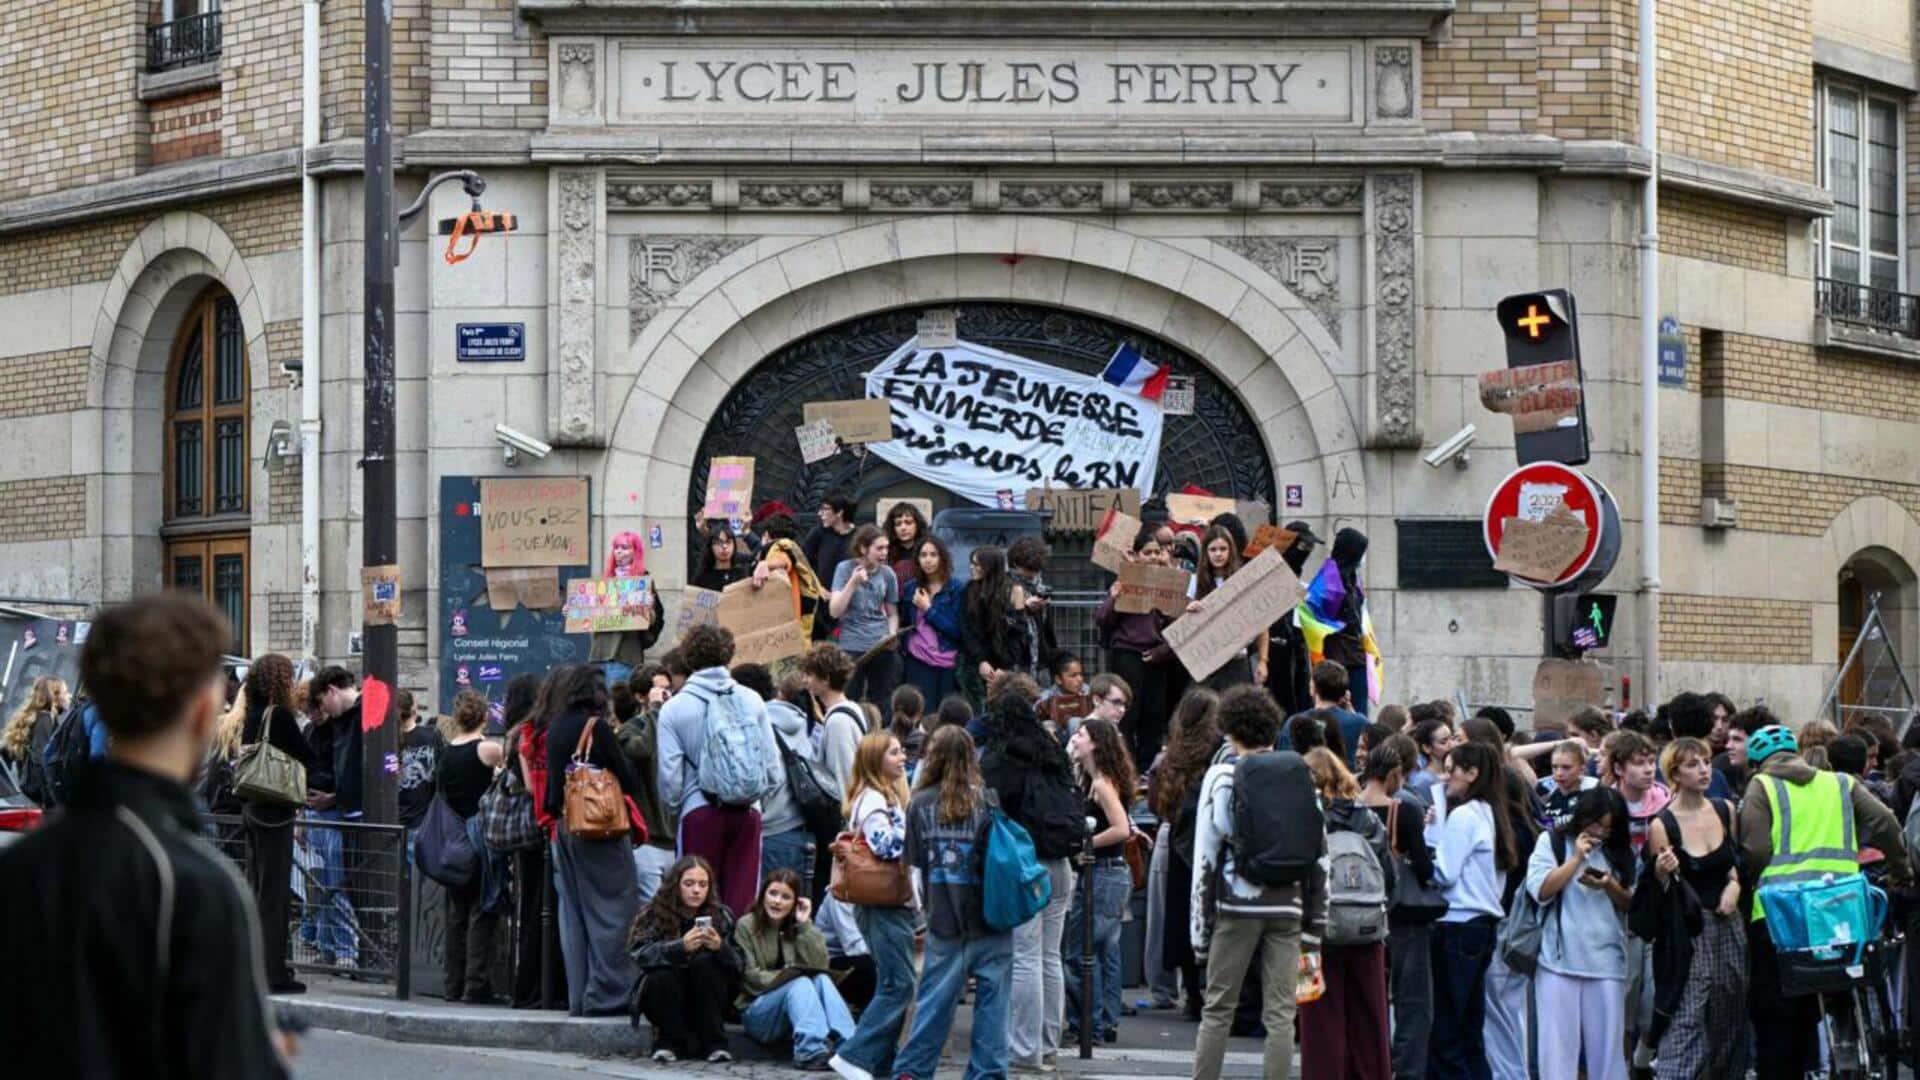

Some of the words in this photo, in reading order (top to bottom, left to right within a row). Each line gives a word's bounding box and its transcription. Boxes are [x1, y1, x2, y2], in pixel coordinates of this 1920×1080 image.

[660, 61, 857, 103] LYCEE
[897, 61, 1079, 105] JULES
[1104, 62, 1303, 104] FERRY
[893, 351, 947, 379] LA
[884, 379, 1066, 446] ENMERDE
[1053, 454, 1088, 487] le
[1086, 462, 1140, 489] RN
[1332, 461, 1363, 498] A
[453, 637, 490, 649] Conseil
[491, 635, 529, 650] régional
